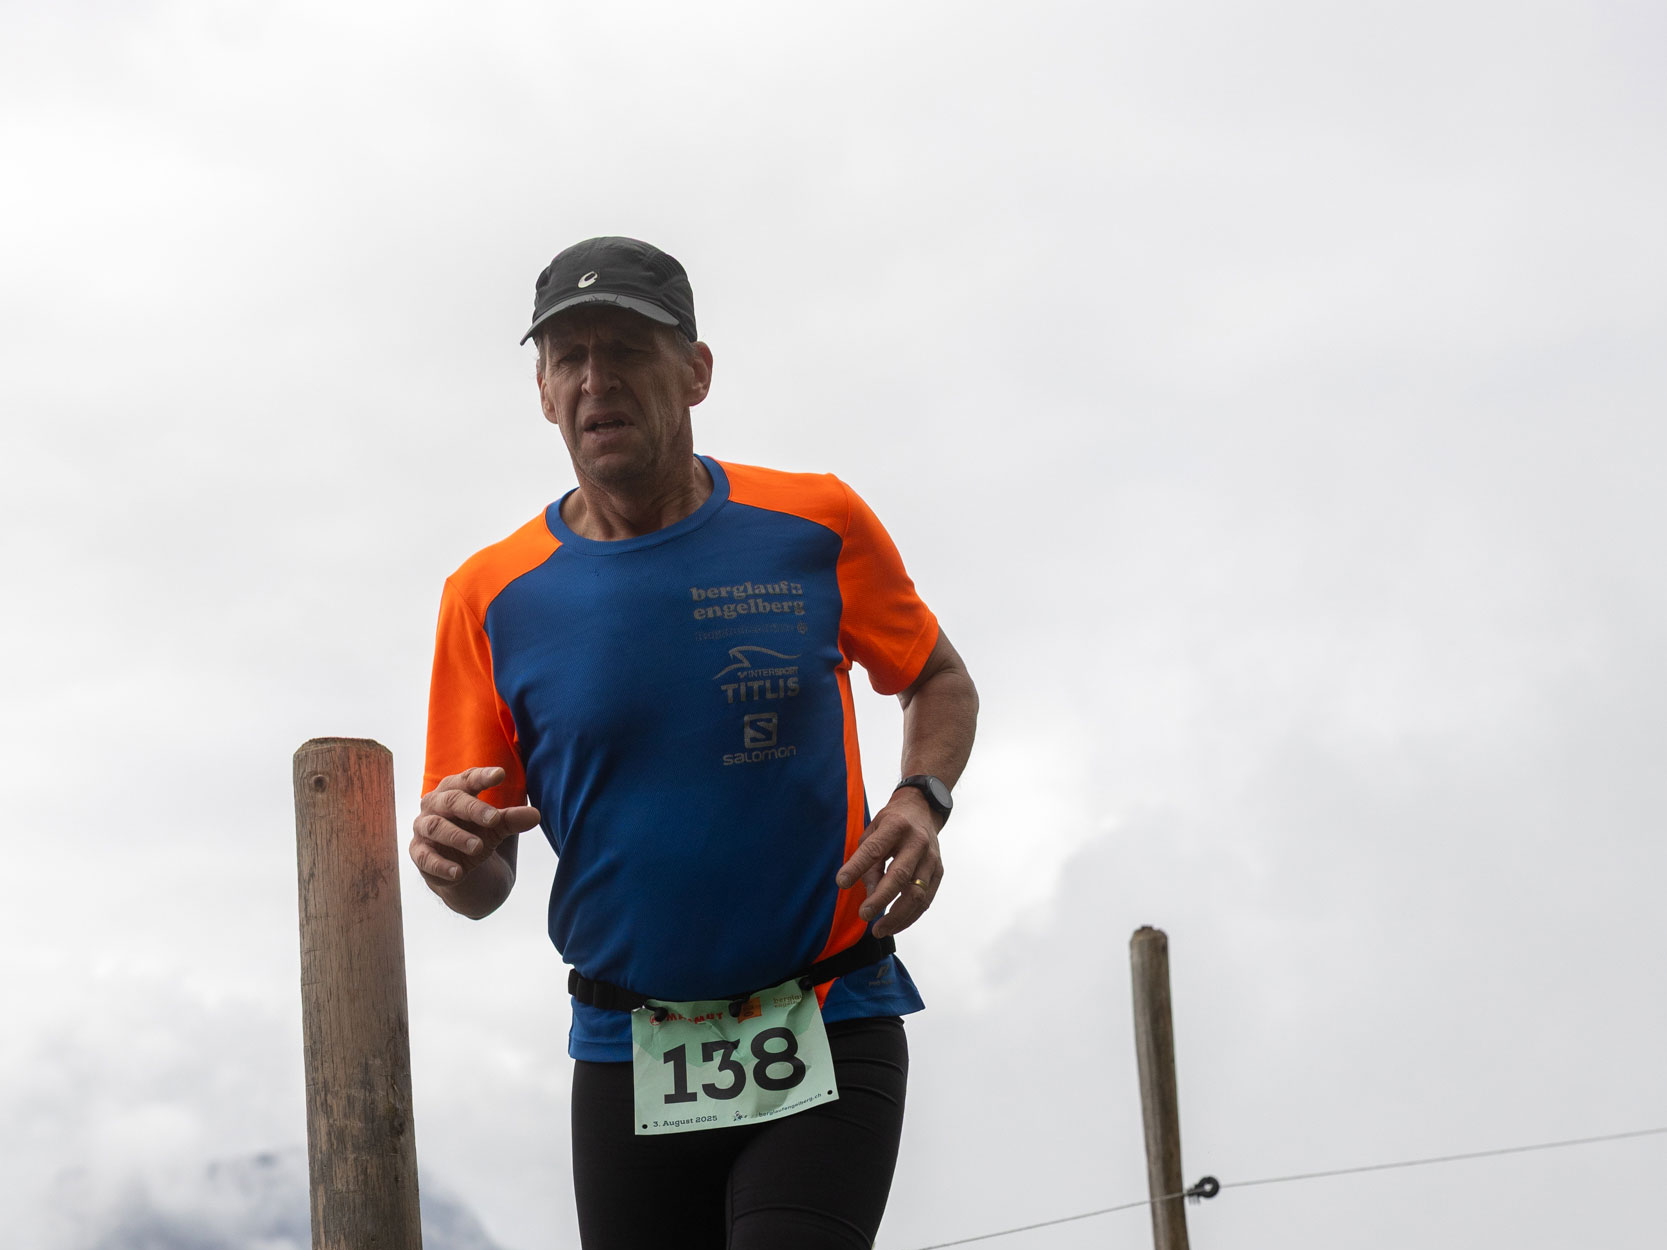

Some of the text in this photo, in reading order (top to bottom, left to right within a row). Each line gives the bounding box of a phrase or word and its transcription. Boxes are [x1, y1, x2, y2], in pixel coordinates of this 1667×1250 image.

[690, 580, 790, 601] berglauf
[693, 598, 806, 620] engelberg
[720, 677, 800, 704] TITLIS
[723, 745, 797, 766] salomon
[663, 1026, 807, 1104] 138
[652, 1114, 718, 1128] 3. August 2025
